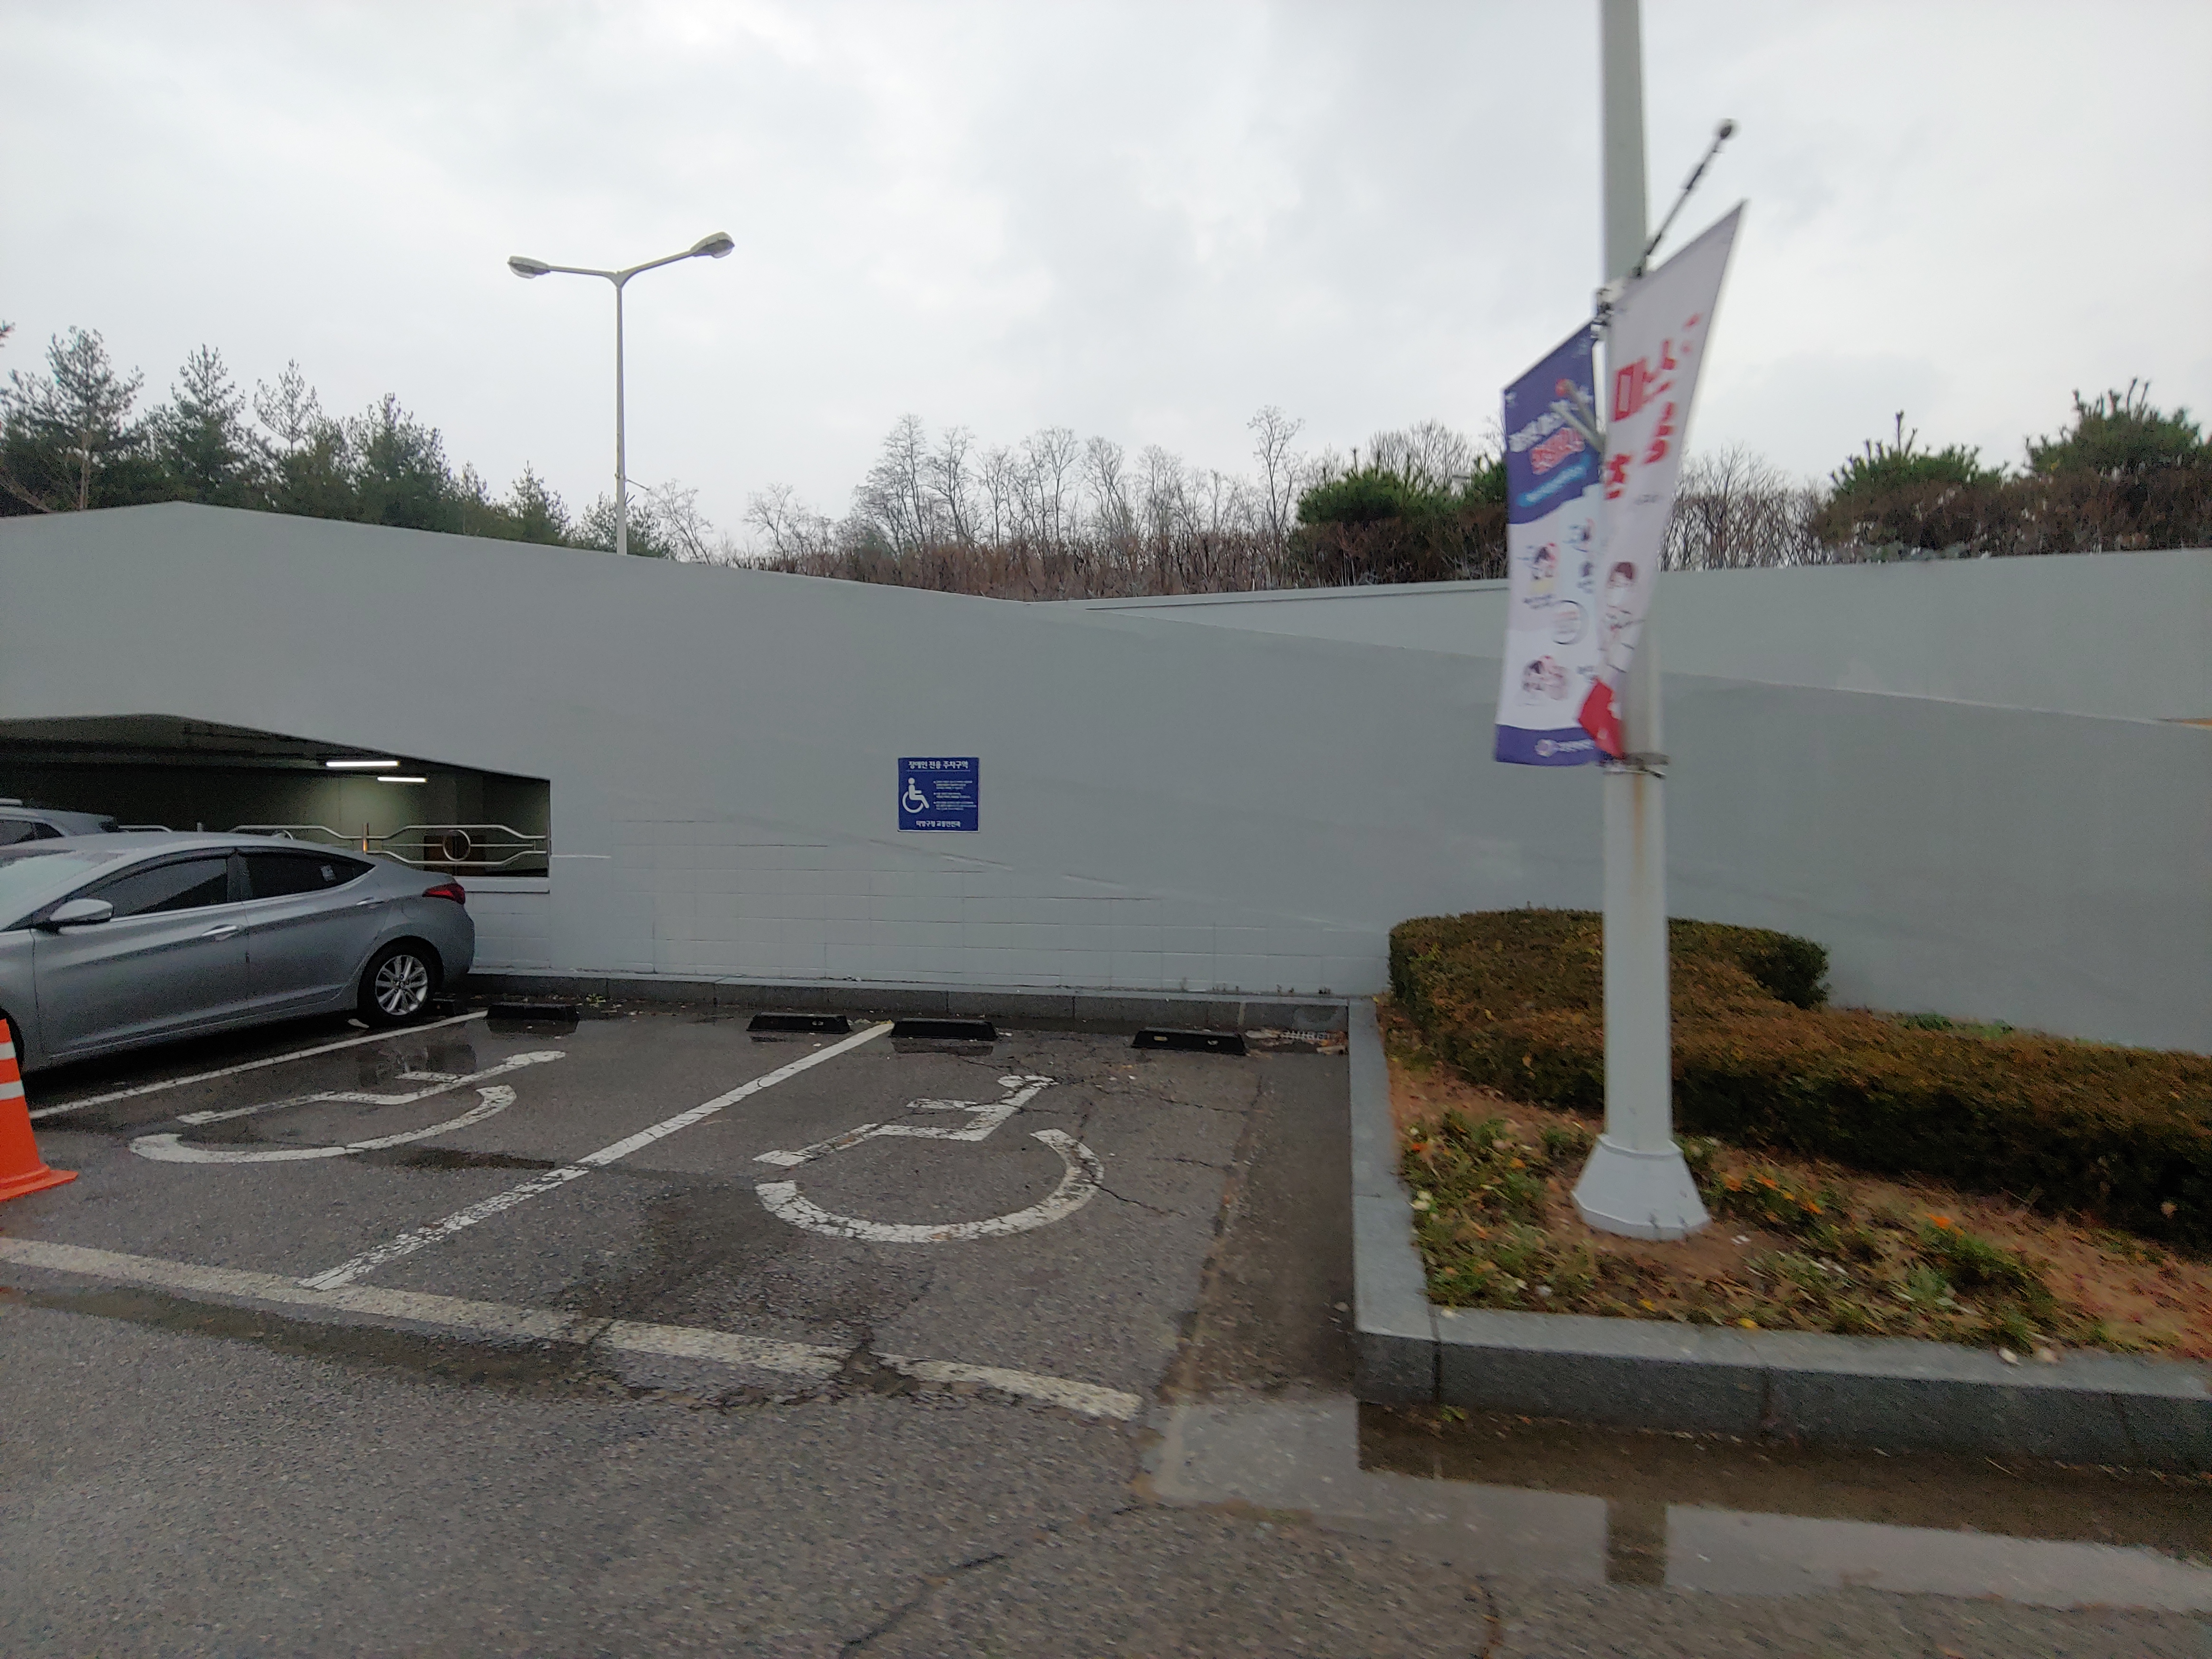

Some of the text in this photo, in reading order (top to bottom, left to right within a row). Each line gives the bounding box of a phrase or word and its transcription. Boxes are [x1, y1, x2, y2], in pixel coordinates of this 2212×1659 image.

[908, 761, 969, 769] 장애인 전용 주차구역
